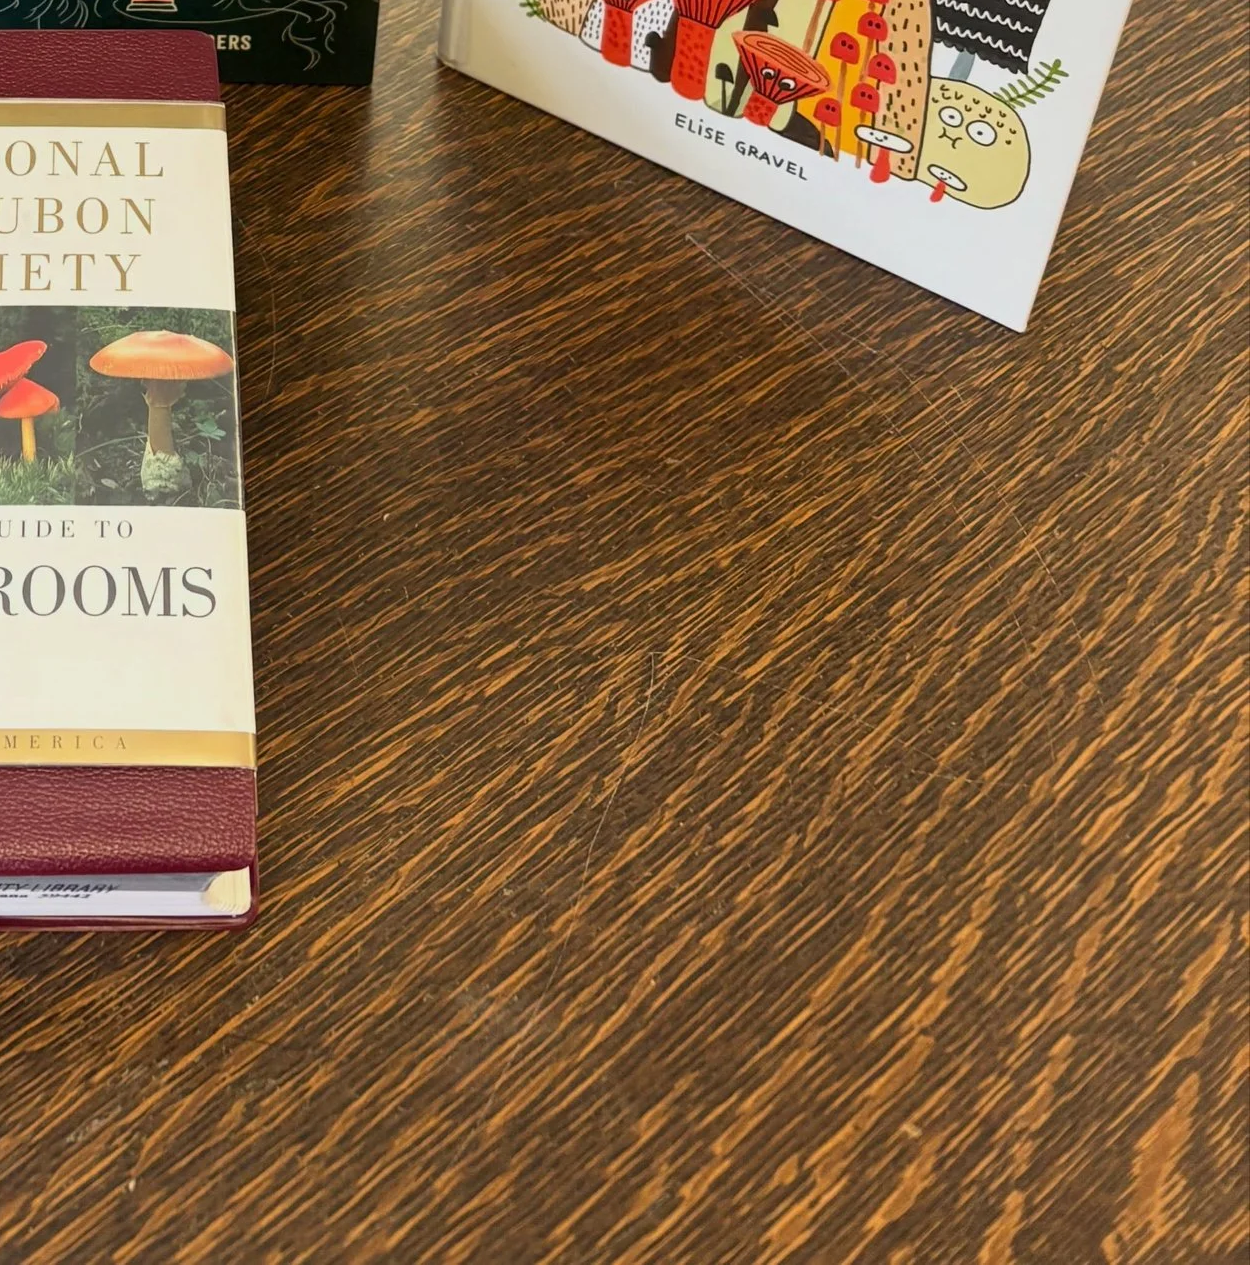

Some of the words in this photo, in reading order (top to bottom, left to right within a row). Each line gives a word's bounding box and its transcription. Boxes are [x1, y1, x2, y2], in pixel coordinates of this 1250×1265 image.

[735, 141, 808, 181] GRAVEL
[94, 520, 135, 539] TO
[30, 883, 120, 894] LIBRARY
